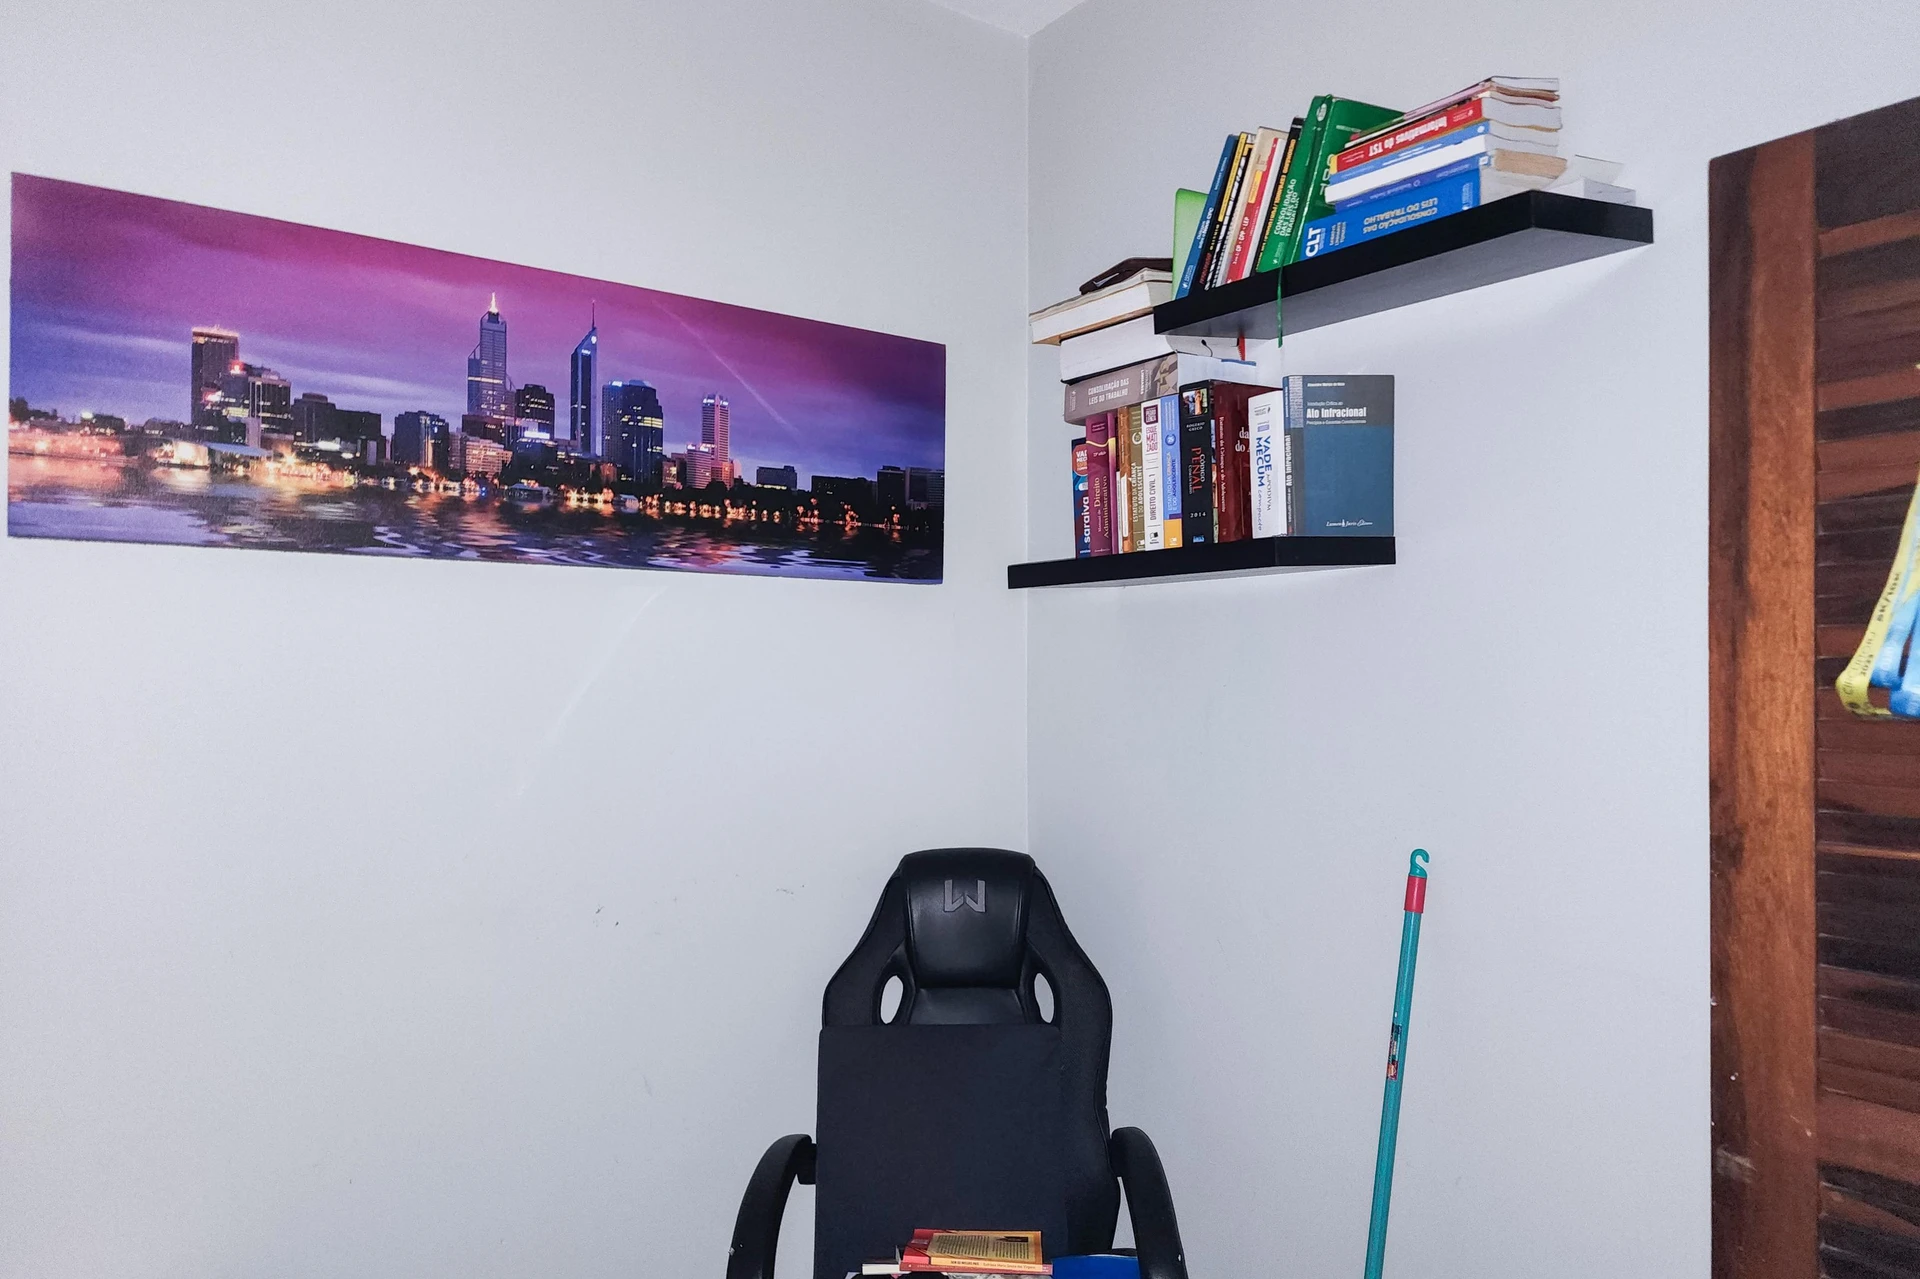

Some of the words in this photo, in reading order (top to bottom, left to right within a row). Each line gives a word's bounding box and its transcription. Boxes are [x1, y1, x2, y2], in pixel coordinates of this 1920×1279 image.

[1396, 116, 1447, 144] Informativos
[1369, 143, 1383, 157] TST
[1384, 137, 1394, 149] do
[1274, 178, 1297, 235] CONSOLIDAÇÃO
[1406, 202, 1420, 213] DO
[1421, 197, 1438, 209] LEIS
[1279, 221, 1288, 236] DAS
[1286, 204, 1294, 221] LEIS
[1290, 191, 1298, 204] DO
[1364, 207, 1406, 225] TRABALHO
[1378, 207, 1438, 229] CONSOLIDAÇÃO
[1363, 223, 1377, 234] DAS
[1305, 227, 1322, 257] CLT
[1088, 379, 1120, 396] CONSOLIDAÇÃO
[1120, 377, 1130, 387] DAS
[1088, 395, 1098, 406] LEIS
[1098, 394, 1105, 403] DO
[1105, 388, 1129, 401] TRABALHO
[1306, 407, 1320, 419] Ato
[1321, 406, 1367, 418] Infracional
[1239, 427, 1250, 438] da
[1235, 440, 1246, 452] do
[1263, 435, 1272, 472] VADE
[1285, 434, 1293, 474] Infracional
[1191, 447, 1203, 493] PENAL
[1256, 437, 1265, 488] MECUM
[1102, 475, 1110, 539] Administrativo
[1083, 496, 1091, 543] saraiva
